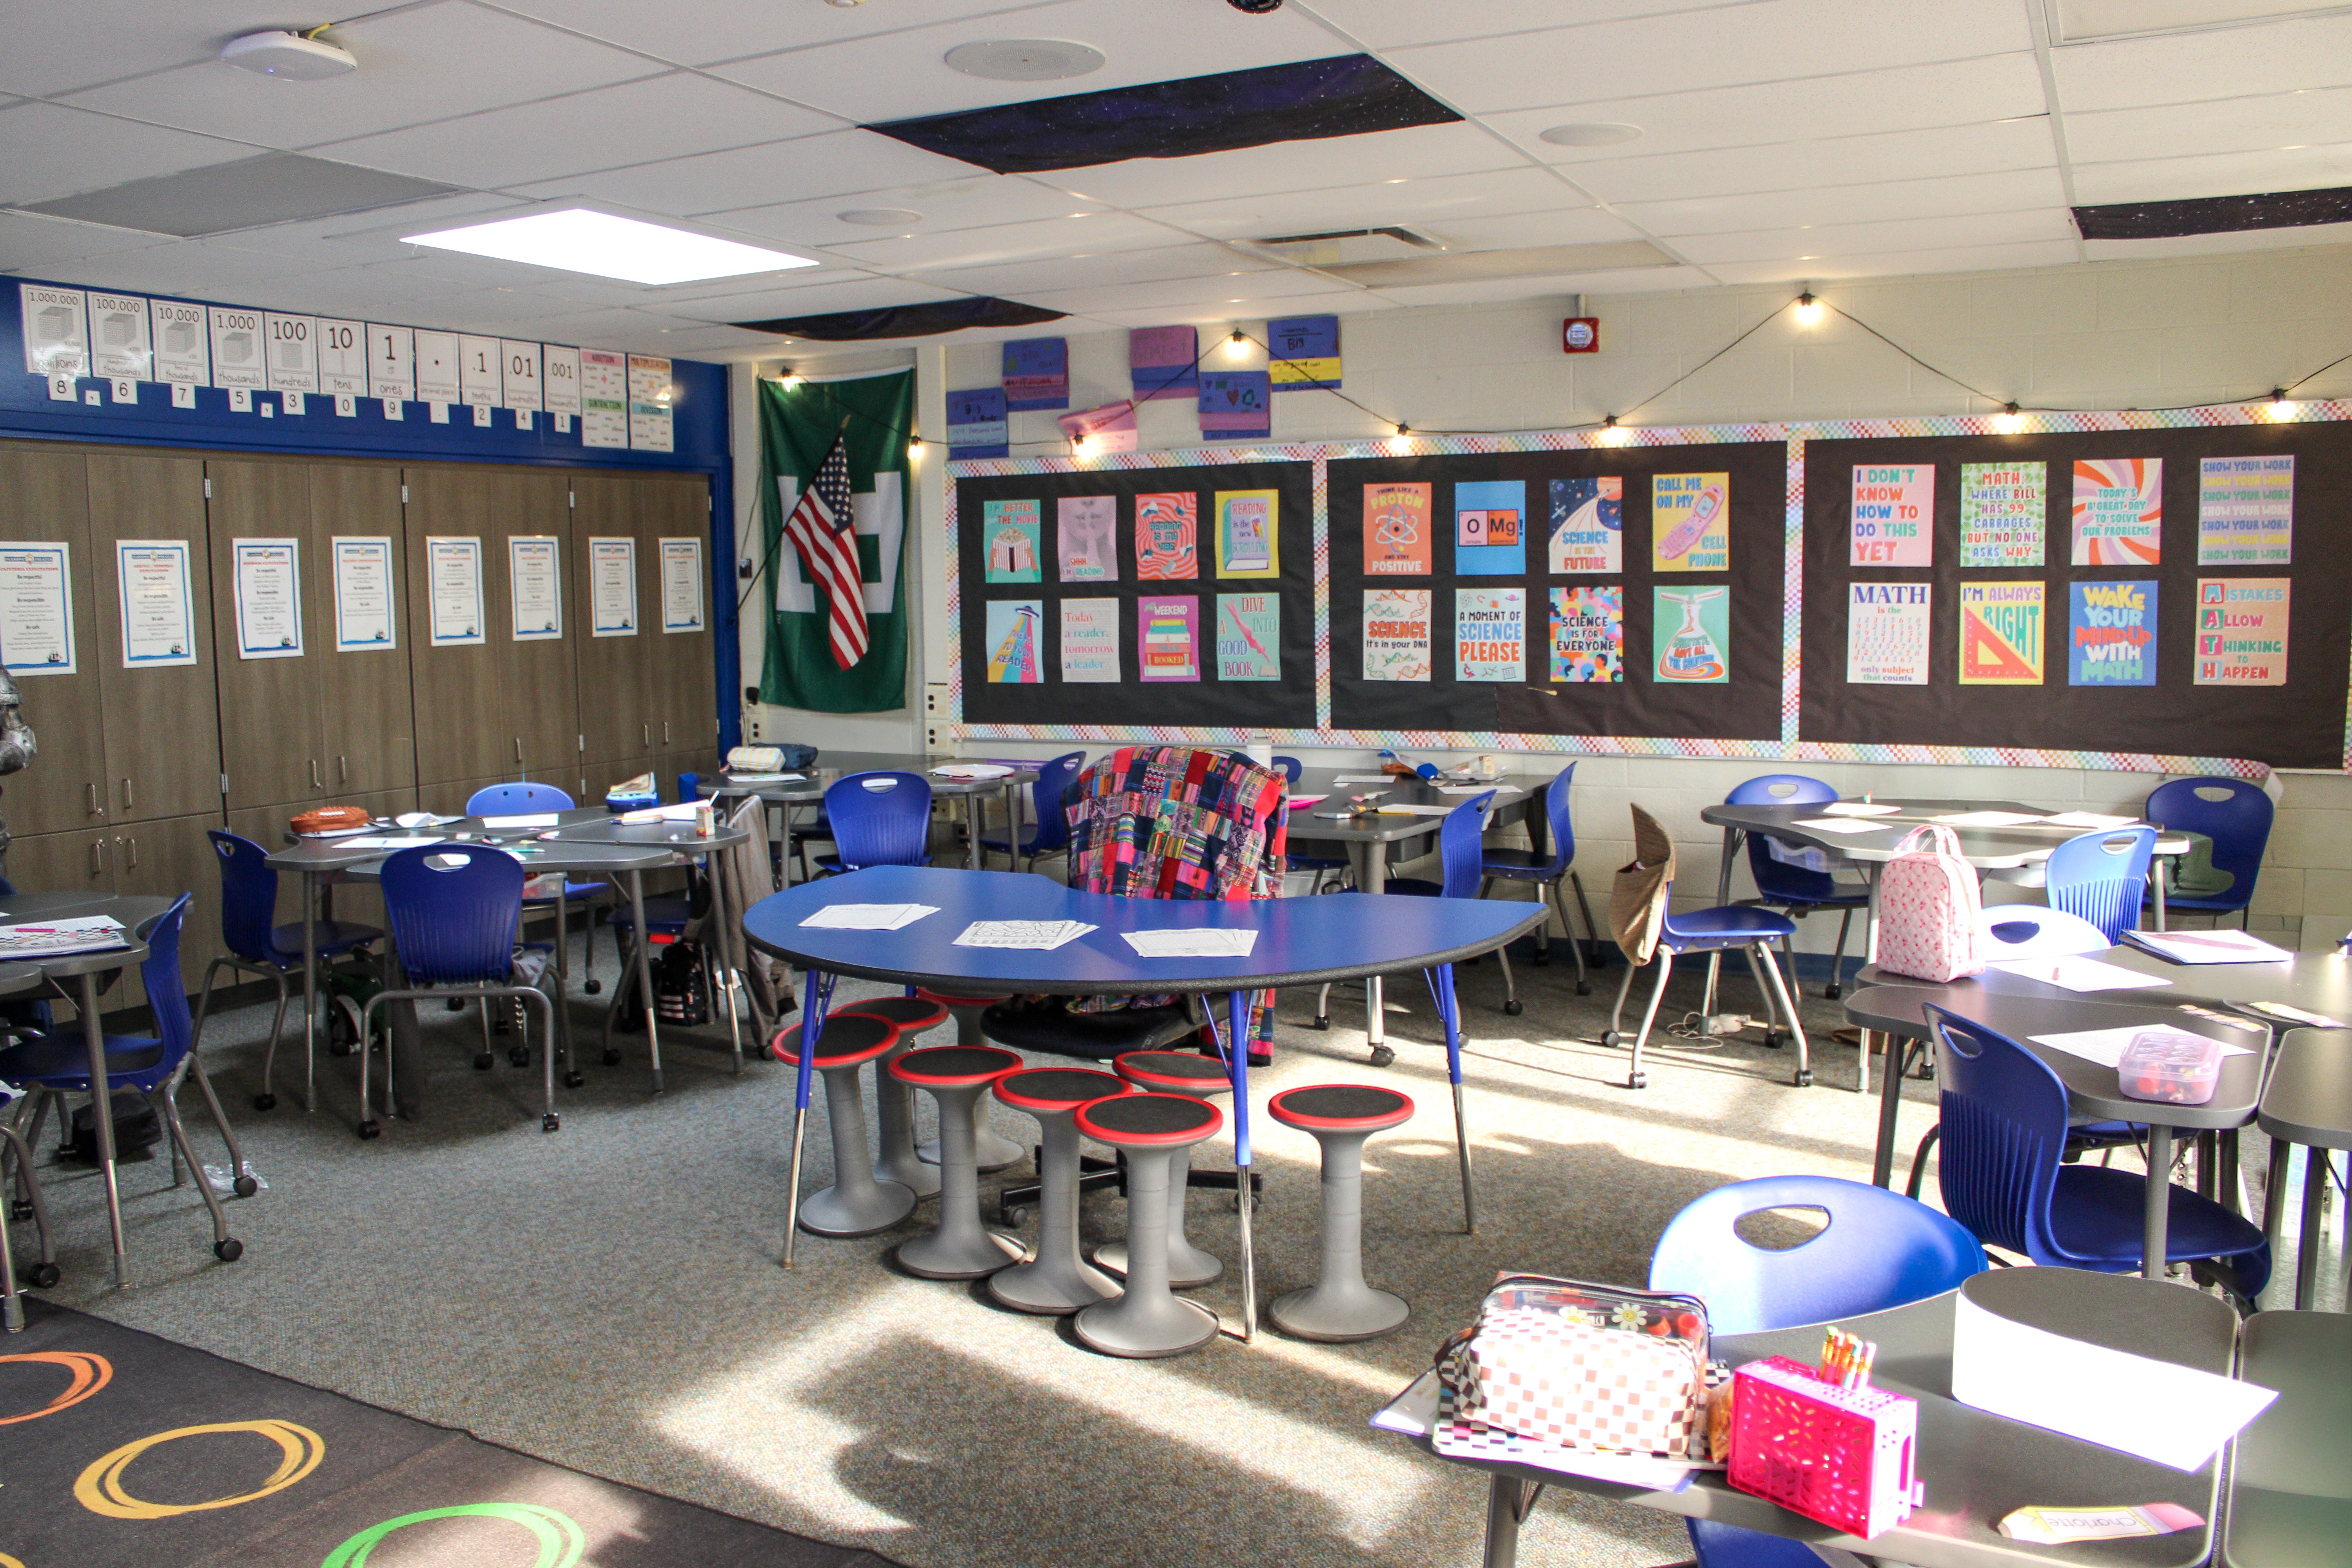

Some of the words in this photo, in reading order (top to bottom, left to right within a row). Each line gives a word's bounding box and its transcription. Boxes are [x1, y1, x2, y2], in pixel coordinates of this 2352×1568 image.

[96, 299, 140, 313] 100,000
[159, 307, 200, 323] 10,000
[217, 314, 255, 330] 1,000
[273, 320, 307, 340] 100
[329, 327, 352, 349] 10
[385, 335, 396, 361] 1
[473, 352, 487, 373] .1
[510, 356, 534, 378] .01
[219, 373, 261, 386] thousands
[273, 376, 312, 389] hundreds
[333, 379, 352, 391] tens
[57, 379, 66, 394] 8
[119, 382, 128, 397] 6
[380, 385, 403, 396] ones
[179, 388, 187, 402] 7
[236, 391, 244, 404] 5
[289, 394, 297, 407] 3
[342, 399, 350, 412] 0
[389, 401, 396, 414] 9
[479, 408, 485, 421] 2
[521, 411, 527, 423] 4
[560, 416, 565, 428] 1
[2203, 462, 2231, 472] SHOW
[2234, 461, 2261, 470] YOUR
[2264, 460, 2291, 470] WORK
[1857, 470, 1861, 483] I
[1869, 469, 1916, 483] DON'T
[1982, 472, 2024, 485] MATH:
[1656, 478, 1682, 492] CALL
[1685, 477, 1702, 490] ME
[1856, 488, 1904, 501] KNOW
[1971, 489, 2008, 499] WHERE
[2014, 489, 2036, 499] BILL
[2203, 492, 2231, 501] SHOW
[2234, 491, 2260, 500] YOUR
[2263, 490, 2290, 499] WORK
[1004, 502, 1033, 513] BETTER
[1370, 493, 1425, 510] PROTON
[1656, 496, 1671, 508] ON
[1675, 495, 1693, 508] MY
[2087, 502, 2093, 511] A
[2097, 501, 2125, 510] GREAT
[2128, 501, 2146, 510] DAY
[1232, 503, 1267, 514] READING
[1857, 505, 1892, 519] HOW
[1899, 505, 1918, 519] TO
[1982, 504, 2003, 514] HAS
[2009, 503, 2025, 514] 99
[998, 515, 1012, 524] THE
[1016, 514, 1038, 524] MOVIE
[1240, 520, 1250, 529] the
[1975, 517, 2031, 528] CABBAGES
[2095, 514, 2107, 523] TO
[2111, 514, 2138, 523] SOLVE
[2202, 521, 2230, 530] SHOW
[2233, 520, 2259, 530] YOUR
[2262, 519, 2289, 529] WORK
[1150, 521, 1181, 530] READING
[1468, 519, 1479, 533] O
[1490, 518, 1515, 536] Mg
[1856, 523, 1876, 537] DO
[1884, 523, 1918, 537] THIS
[2082, 526, 2101, 535] OUR
[2104, 526, 2150, 535] PROBLEMS
[1563, 531, 1608, 544] SCIENCE
[1702, 536, 1727, 549] CELL
[1967, 533, 1989, 543] BUT
[1995, 533, 2009, 542] NO
[2016, 532, 2037, 542] ONE
[1157, 543, 1175, 551] VIBE
[1855, 541, 1897, 561] YET
[1973, 547, 1999, 557] ASKS
[2006, 546, 2032, 557] WHY
[1688, 554, 1727, 566] PHONE
[2202, 550, 2229, 559] SHOW
[2232, 550, 2258, 559] YOUR
[2261, 550, 2288, 559] WORK
[1372, 560, 1422, 572] POSITIVE
[1564, 557, 1606, 570] FUTURE
[1854, 586, 1927, 604] MATH
[1963, 588, 1983, 601] I'M
[1989, 587, 2041, 601] ALWAYS
[2083, 584, 2146, 610] WAKE
[2204, 585, 2283, 603] MISTAKES
[1154, 606, 1187, 615] WEEKEND
[1242, 597, 1267, 613] DIVE
[1065, 612, 1093, 624] Today
[1460, 612, 1465, 621] A
[1468, 612, 1505, 621] MOMENT
[1510, 611, 1521, 621] OF
[1562, 616, 1609, 627] SCIENCE
[2084, 606, 2143, 628] YOUR
[2205, 610, 2263, 628] ALLOW
[1219, 619, 1227, 635] A
[1253, 618, 1278, 633] INTO
[1368, 621, 1426, 639] SCIENCE
[1459, 623, 1522, 640] SCIENCE
[1583, 629, 1599, 638] FOR
[1984, 606, 2040, 665] RIGHT
[2075, 626, 2127, 647] MIND
[2127, 626, 2152, 647] UP
[1065, 645, 1113, 654] tomorrow
[1218, 640, 1248, 656] GOOD
[1367, 640, 1378, 648] It's
[1414, 641, 1427, 649] DNA
[1557, 641, 1615, 651] EVERYONE
[2206, 637, 2282, 654] THINKING
[1460, 642, 1520, 662] PLEASE
[2085, 641, 2141, 663] WITH
[996, 655, 1032, 675] READER
[1074, 659, 1105, 669] leader
[1225, 661, 1254, 676] BOOK
[1882, 666, 1914, 675] subject
[2081, 659, 2143, 682] MATH
[2203, 663, 2269, 679] HAPPEN
[2047, 1517, 2136, 1529] Charlotte
